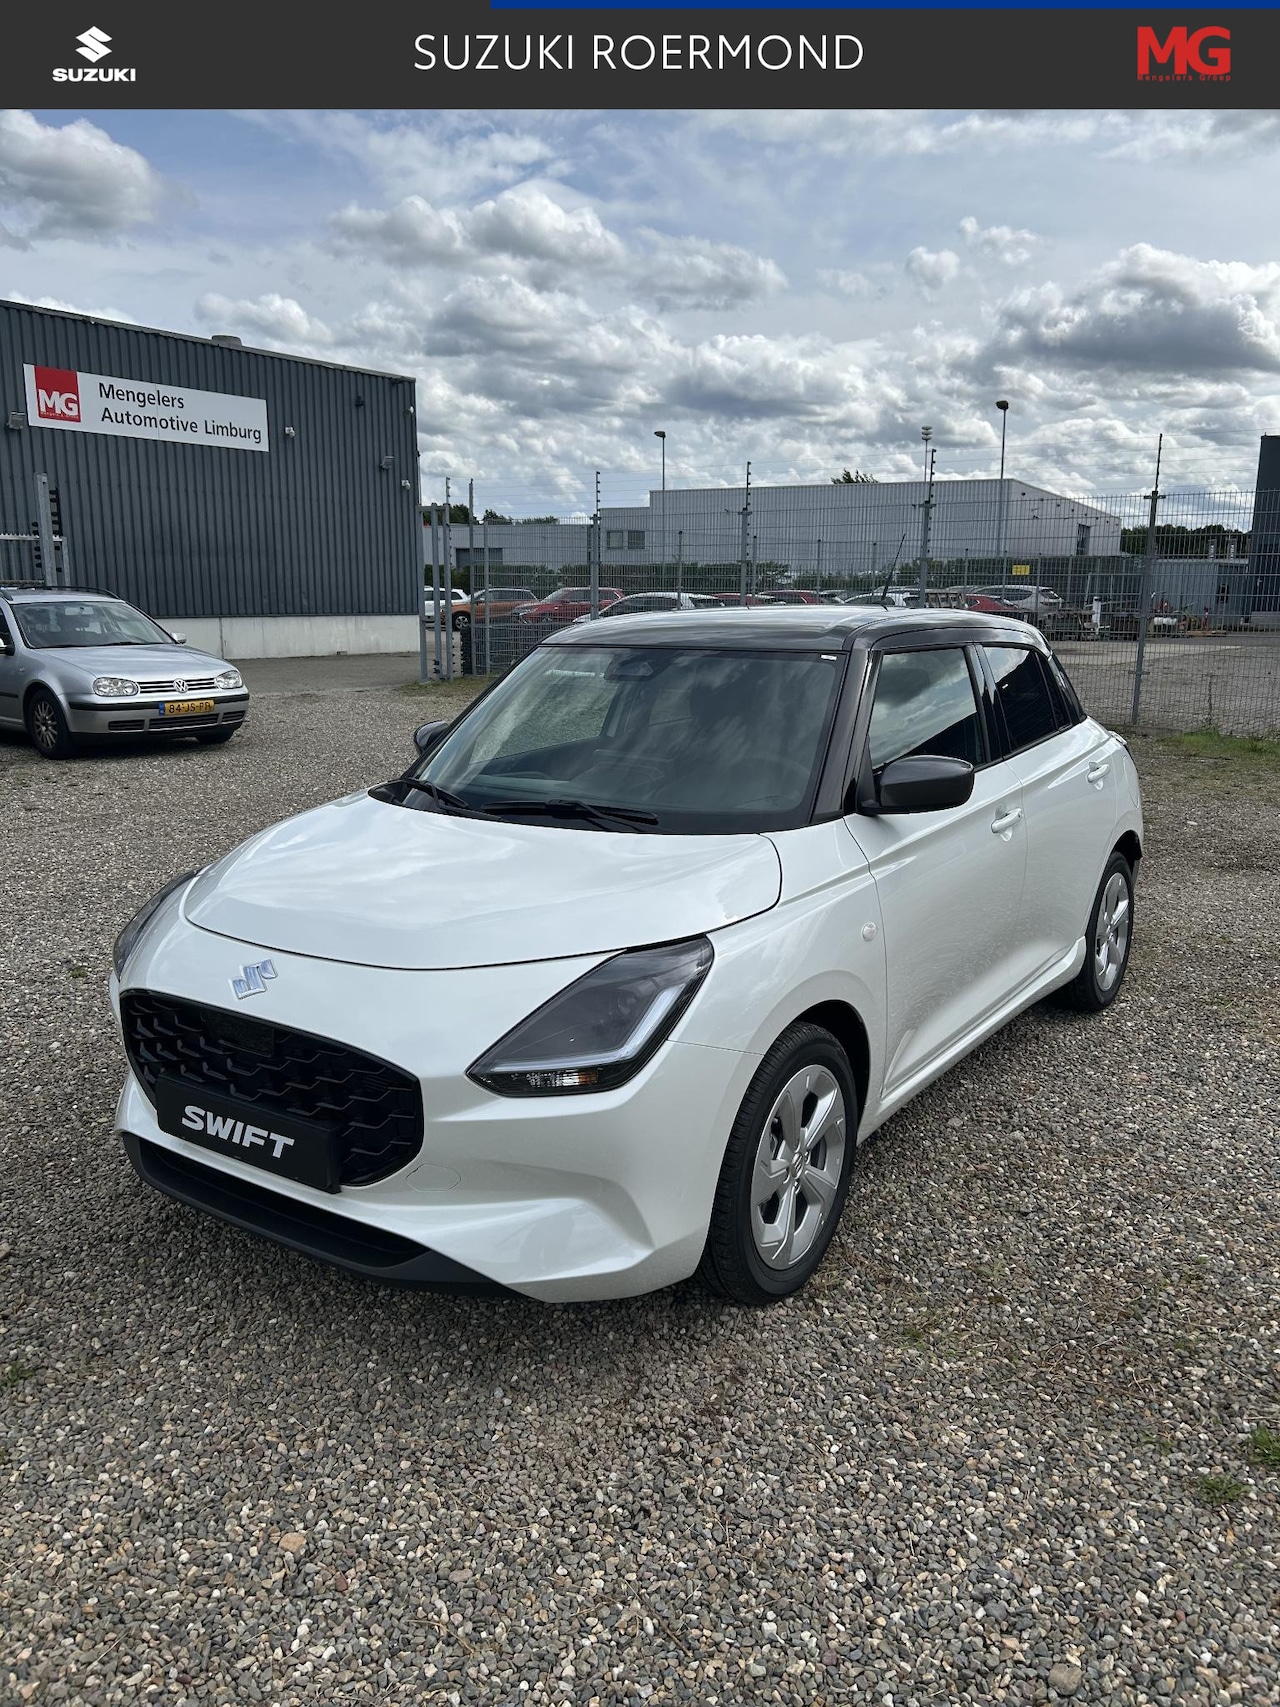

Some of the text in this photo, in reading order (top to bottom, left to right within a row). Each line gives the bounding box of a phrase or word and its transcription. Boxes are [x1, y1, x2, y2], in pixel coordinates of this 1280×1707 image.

[39, 389, 79, 416] MG
[99, 382, 185, 409] Mengelers
[101, 407, 262, 444] Automotive Limburg
[181, 1105, 295, 1158] SWIFT
